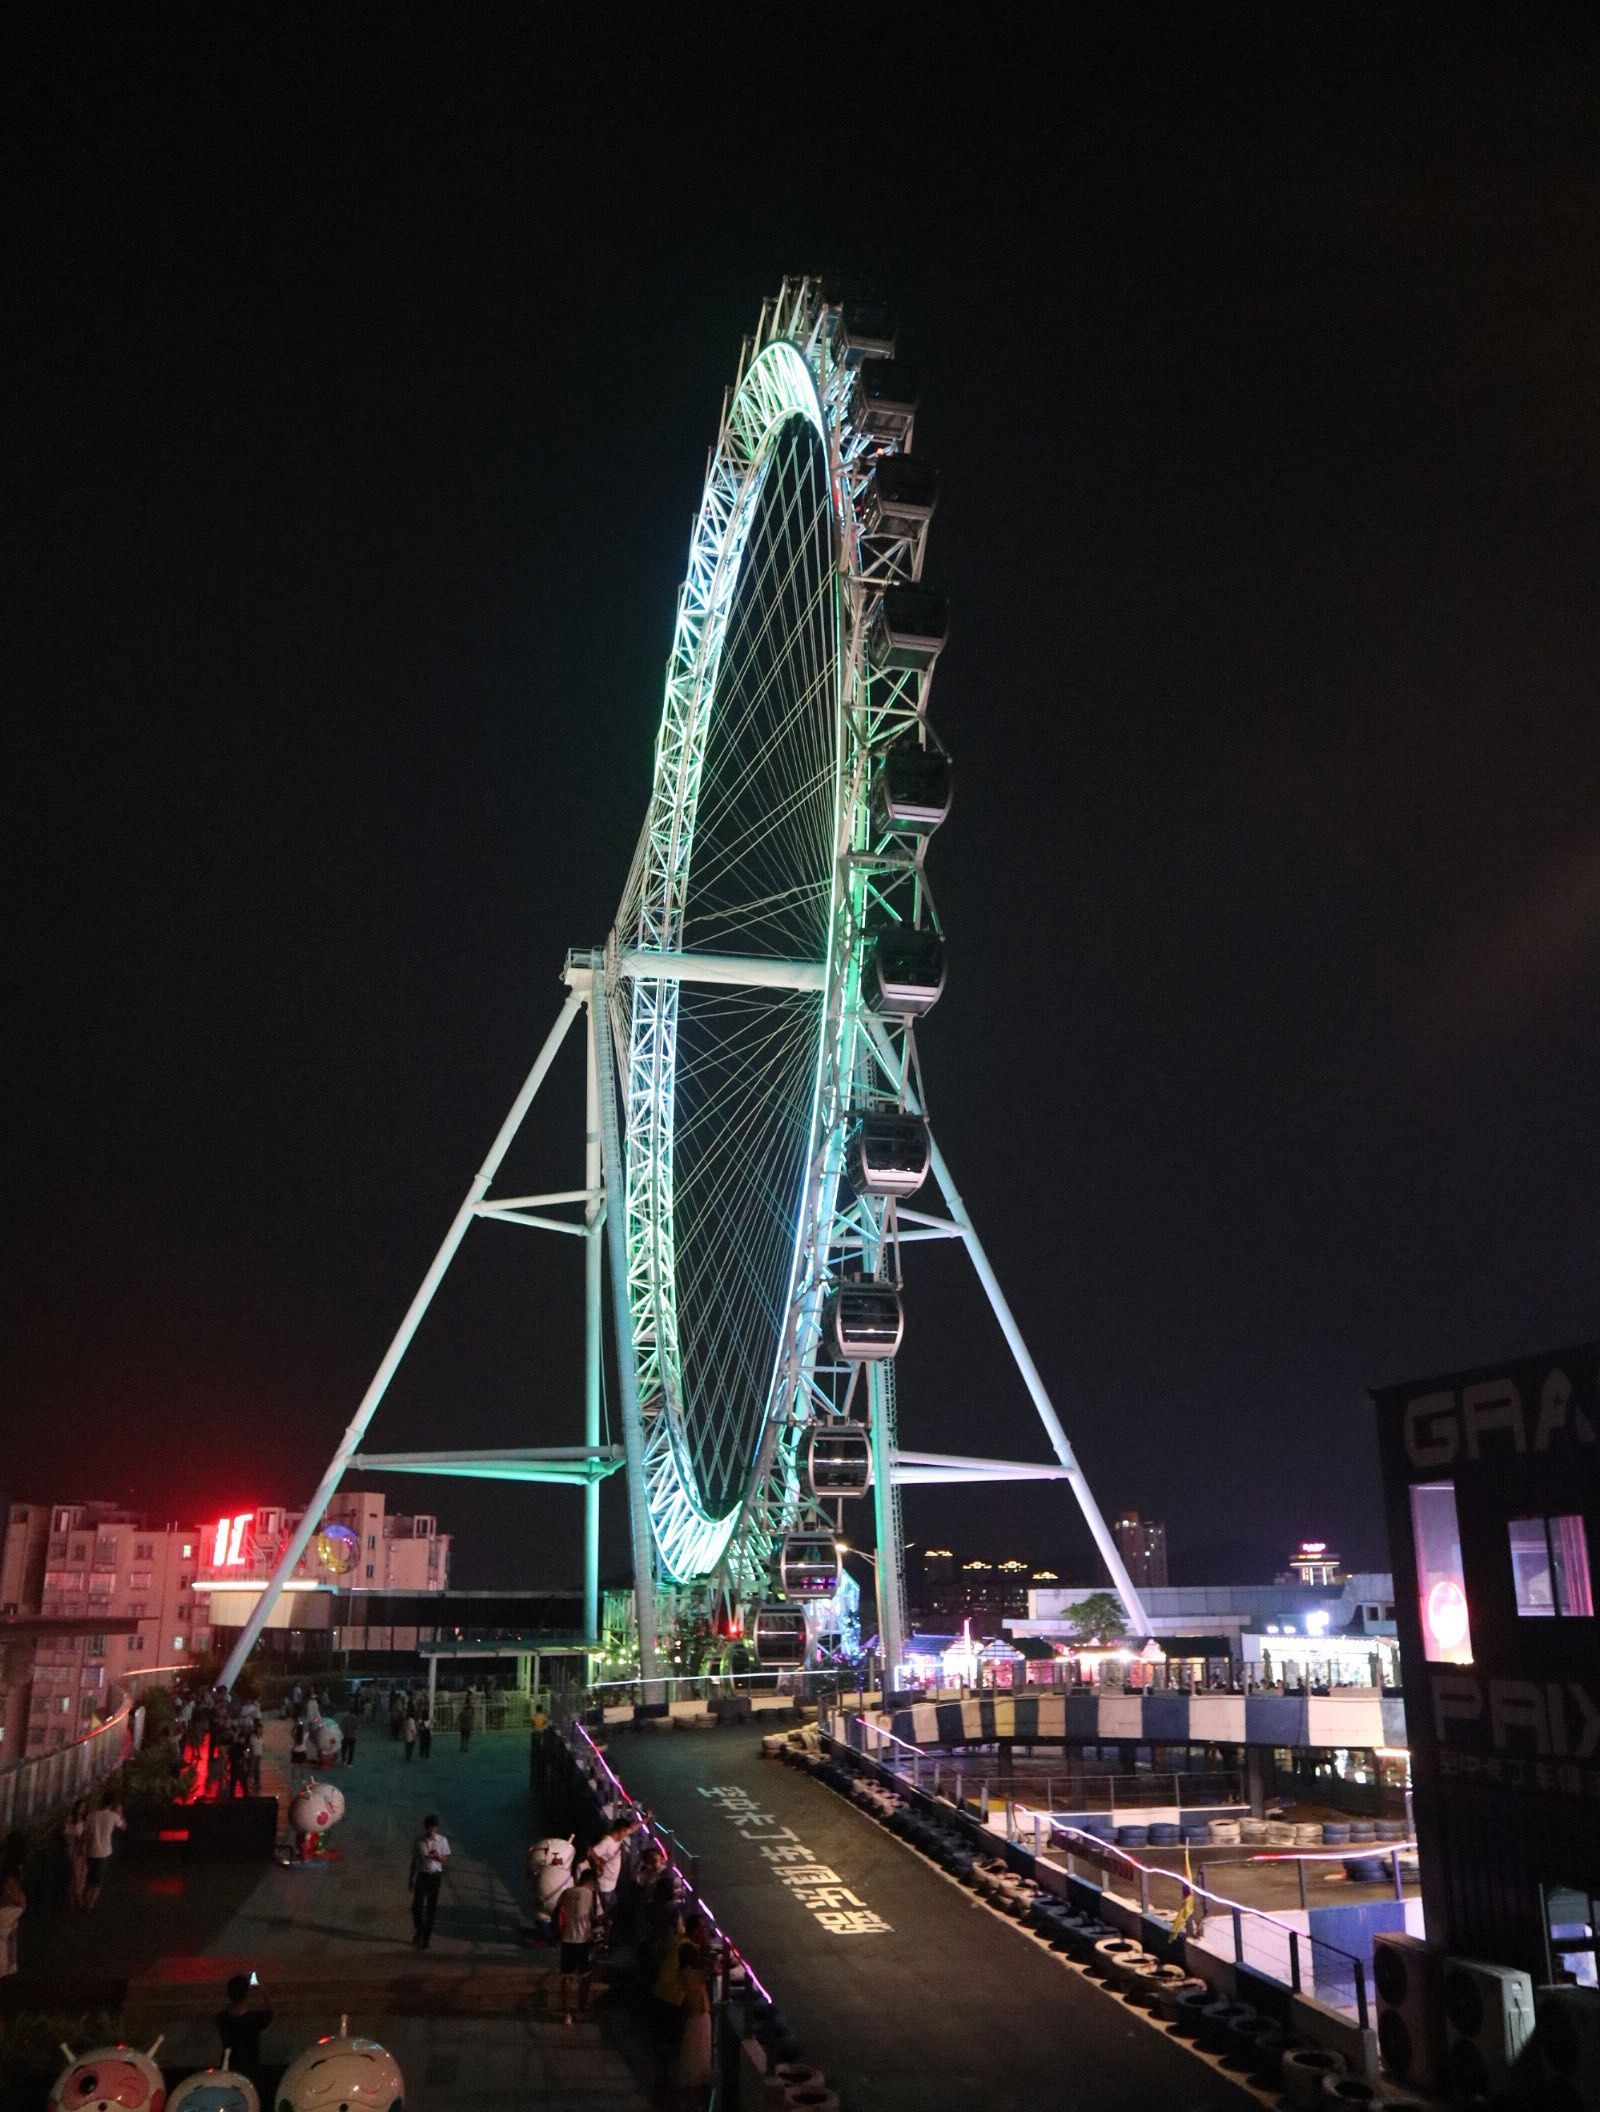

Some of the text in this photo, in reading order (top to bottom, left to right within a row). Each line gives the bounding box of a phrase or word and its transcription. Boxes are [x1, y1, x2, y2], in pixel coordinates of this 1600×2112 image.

[696, 1786, 895, 1935] 空中卡丁车俱乐部
